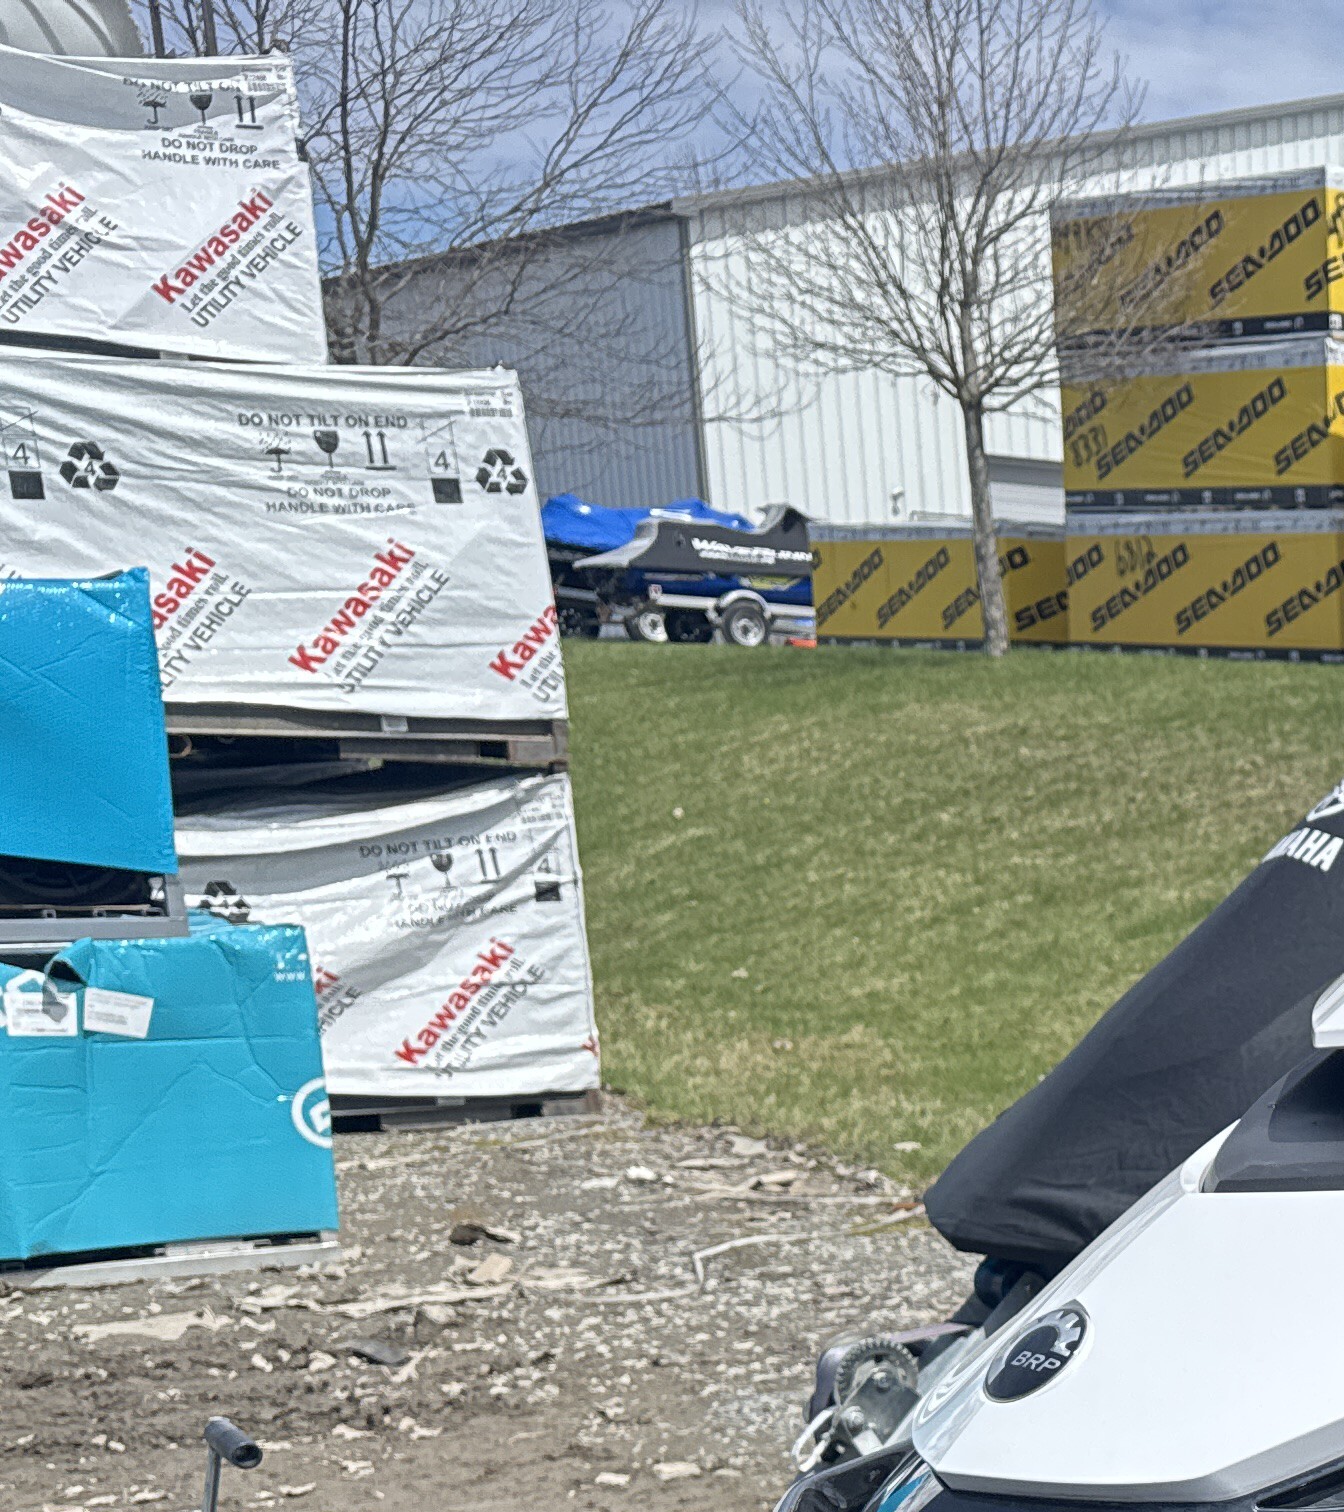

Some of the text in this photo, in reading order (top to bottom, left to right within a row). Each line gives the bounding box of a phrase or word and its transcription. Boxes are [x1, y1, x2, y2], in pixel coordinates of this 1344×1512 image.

[141, 149, 281, 170] HANDLE WITH CARE
[162, 137, 258, 156] DO NOT DROP
[0, 181, 86, 282] wasaki
[151, 187, 274, 304] Kawasaki
[0, 215, 119, 325] UTILITY VEHICLE
[190, 221, 304, 328] UTILITY VEHICLE
[13, 443, 30, 466] 4
[238, 413, 408, 428] DO NOT TILT ON END
[313, 486, 346, 499] NOT
[351, 486, 391, 499] DROP
[434, 450, 451, 471] 4
[265, 501, 328, 515] HANDLE
[332, 502, 371, 515] WITH
[152, 546, 216, 631] asaki
[183, 580, 252, 652] VEHICLE
[287, 537, 417, 675] Kawasaki
[384, 569, 451, 638] VEHICLE
[489, 604, 557, 681] Kawa
[359, 845, 383, 858] DO
[387, 841, 421, 857] NOT
[424, 836, 454, 852] TILT
[394, 937, 516, 1066] Kawasaki
[482, 962, 546, 1032] VEHICLE
[1010, 1350, 1061, 1372] BRP
